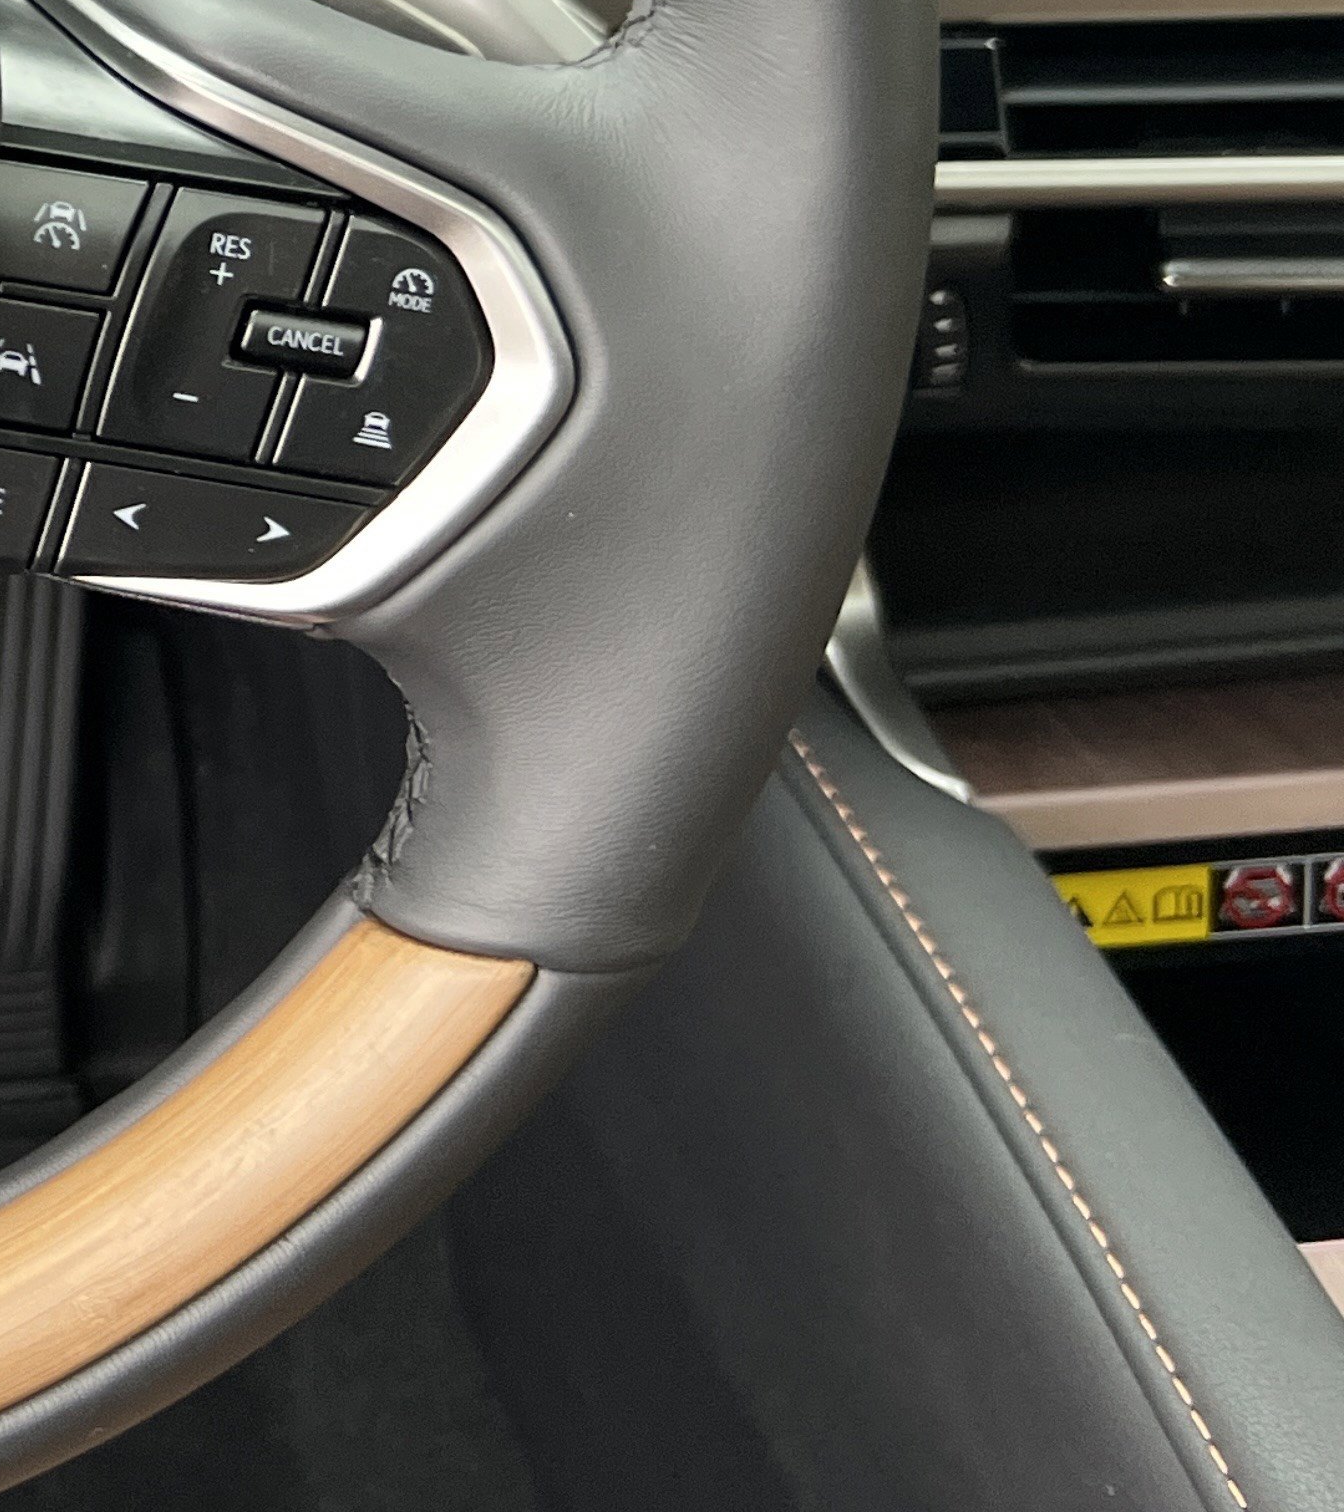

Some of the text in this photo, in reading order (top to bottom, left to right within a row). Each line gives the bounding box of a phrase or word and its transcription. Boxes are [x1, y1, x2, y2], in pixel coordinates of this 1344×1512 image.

[211, 232, 251, 261] RES
[389, 291, 432, 314] MODE
[267, 325, 344, 357] CANCEL
